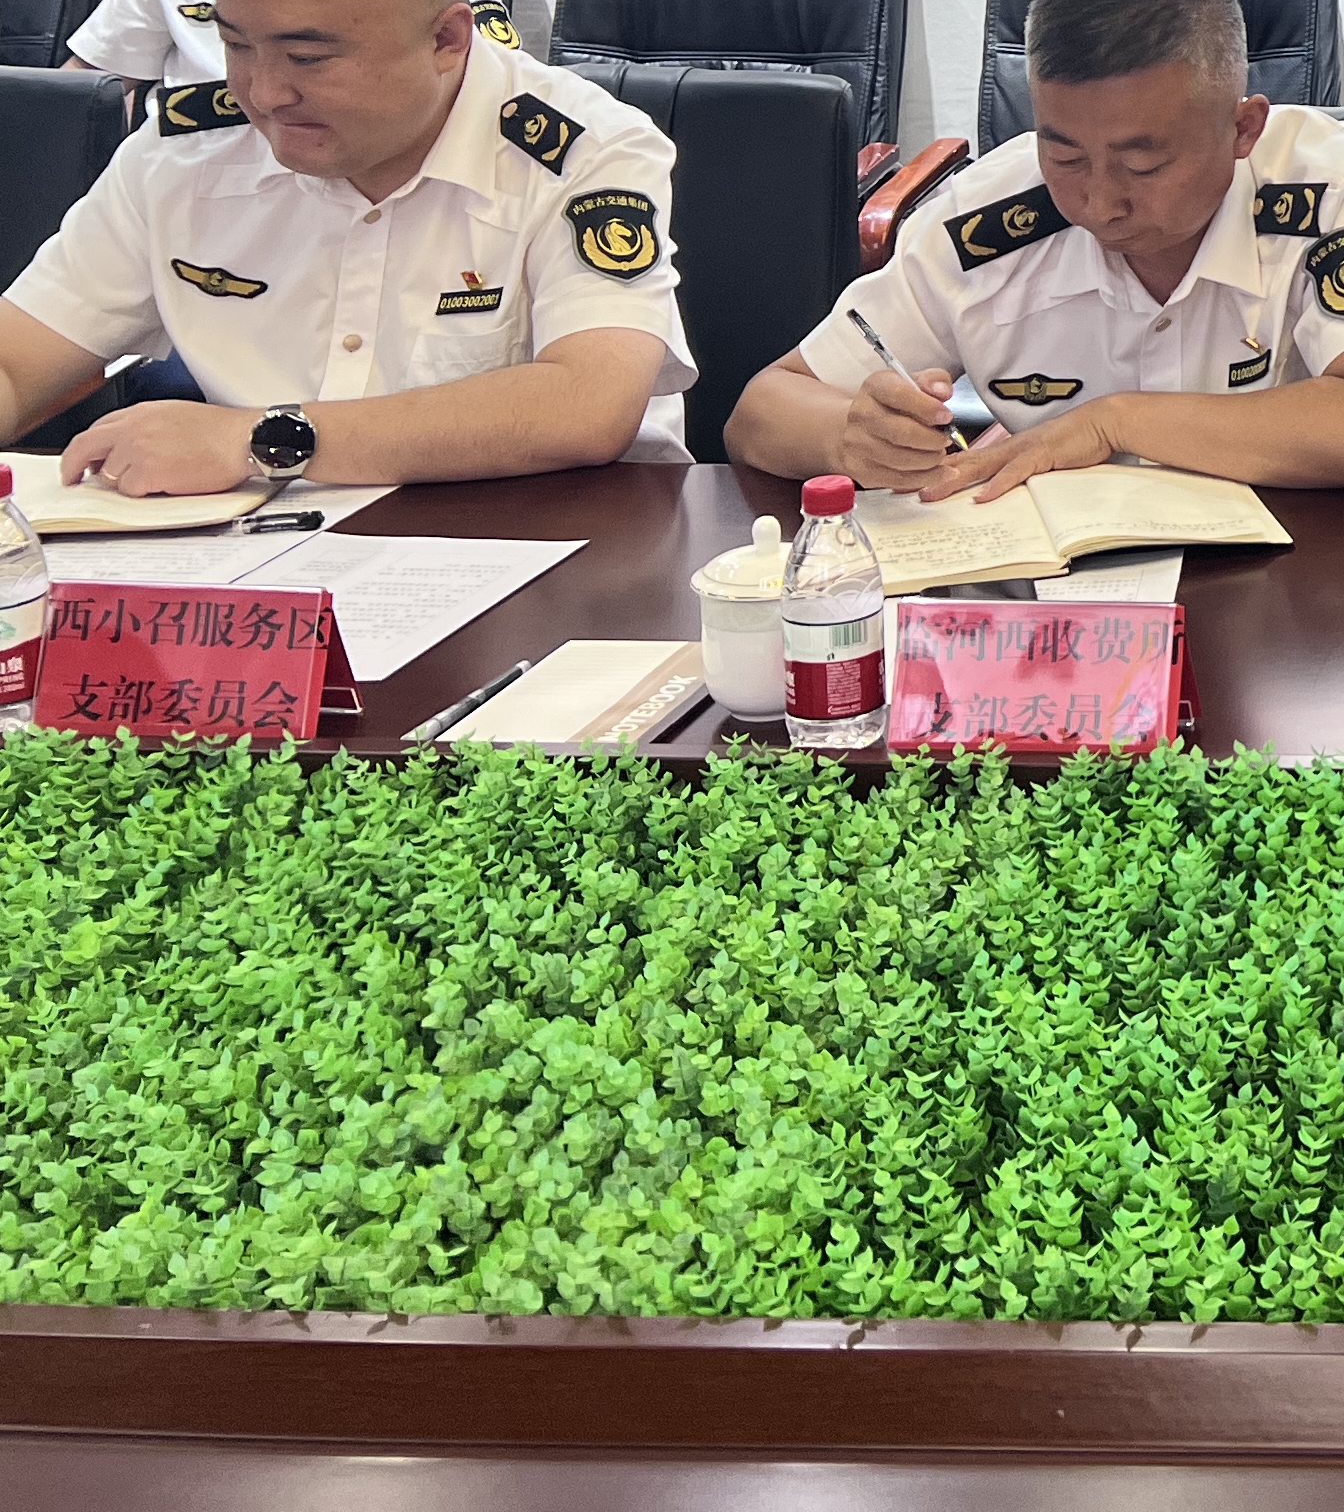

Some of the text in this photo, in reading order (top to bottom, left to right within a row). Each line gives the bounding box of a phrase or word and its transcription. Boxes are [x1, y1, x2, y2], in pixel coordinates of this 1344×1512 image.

[49, 597, 333, 651] 西小召服务区
[58, 673, 299, 728] 支部委员会
[598, 675, 697, 742] NOTEBOOK
[917, 691, 1153, 742] 支部委员会
